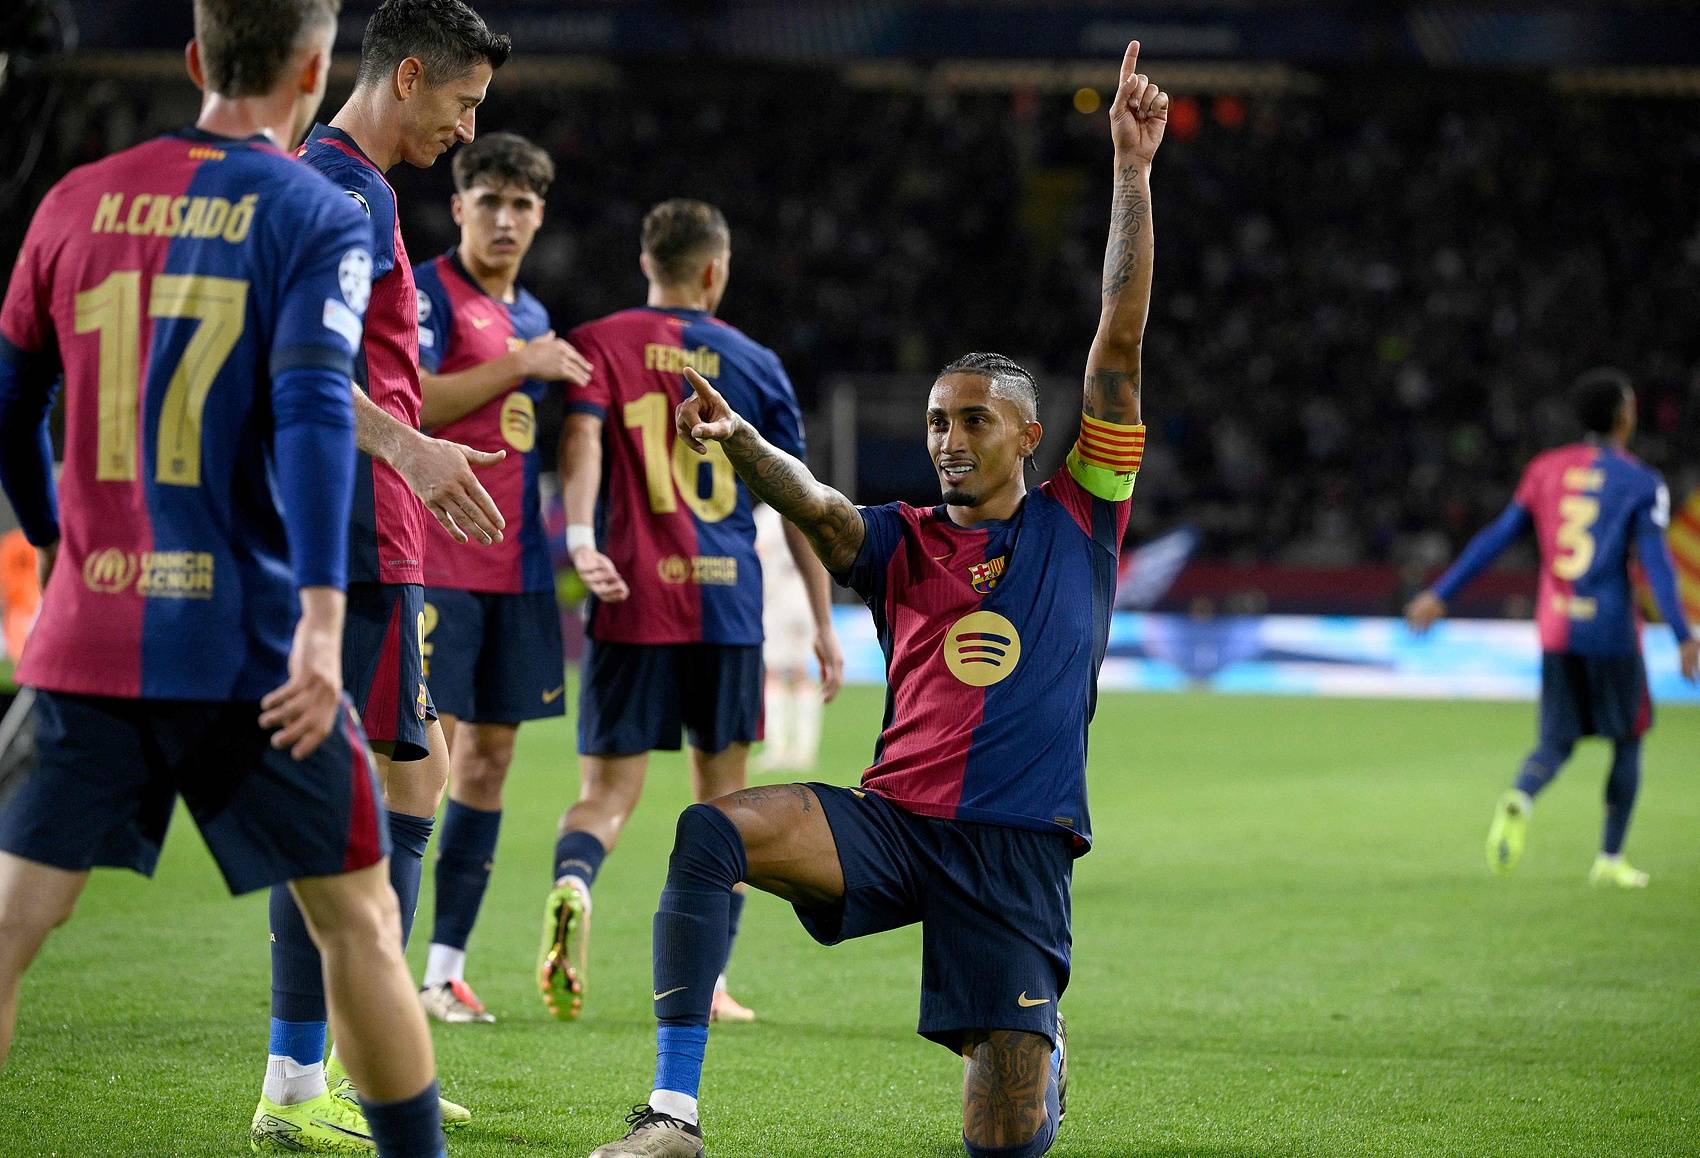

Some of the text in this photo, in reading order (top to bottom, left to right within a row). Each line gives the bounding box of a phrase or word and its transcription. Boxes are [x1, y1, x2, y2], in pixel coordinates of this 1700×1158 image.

[92, 193, 258, 243] M.CASADÓ
[75, 271, 249, 487] 17
[623, 392, 736, 522] 16
[1552, 495, 1599, 580] 3
